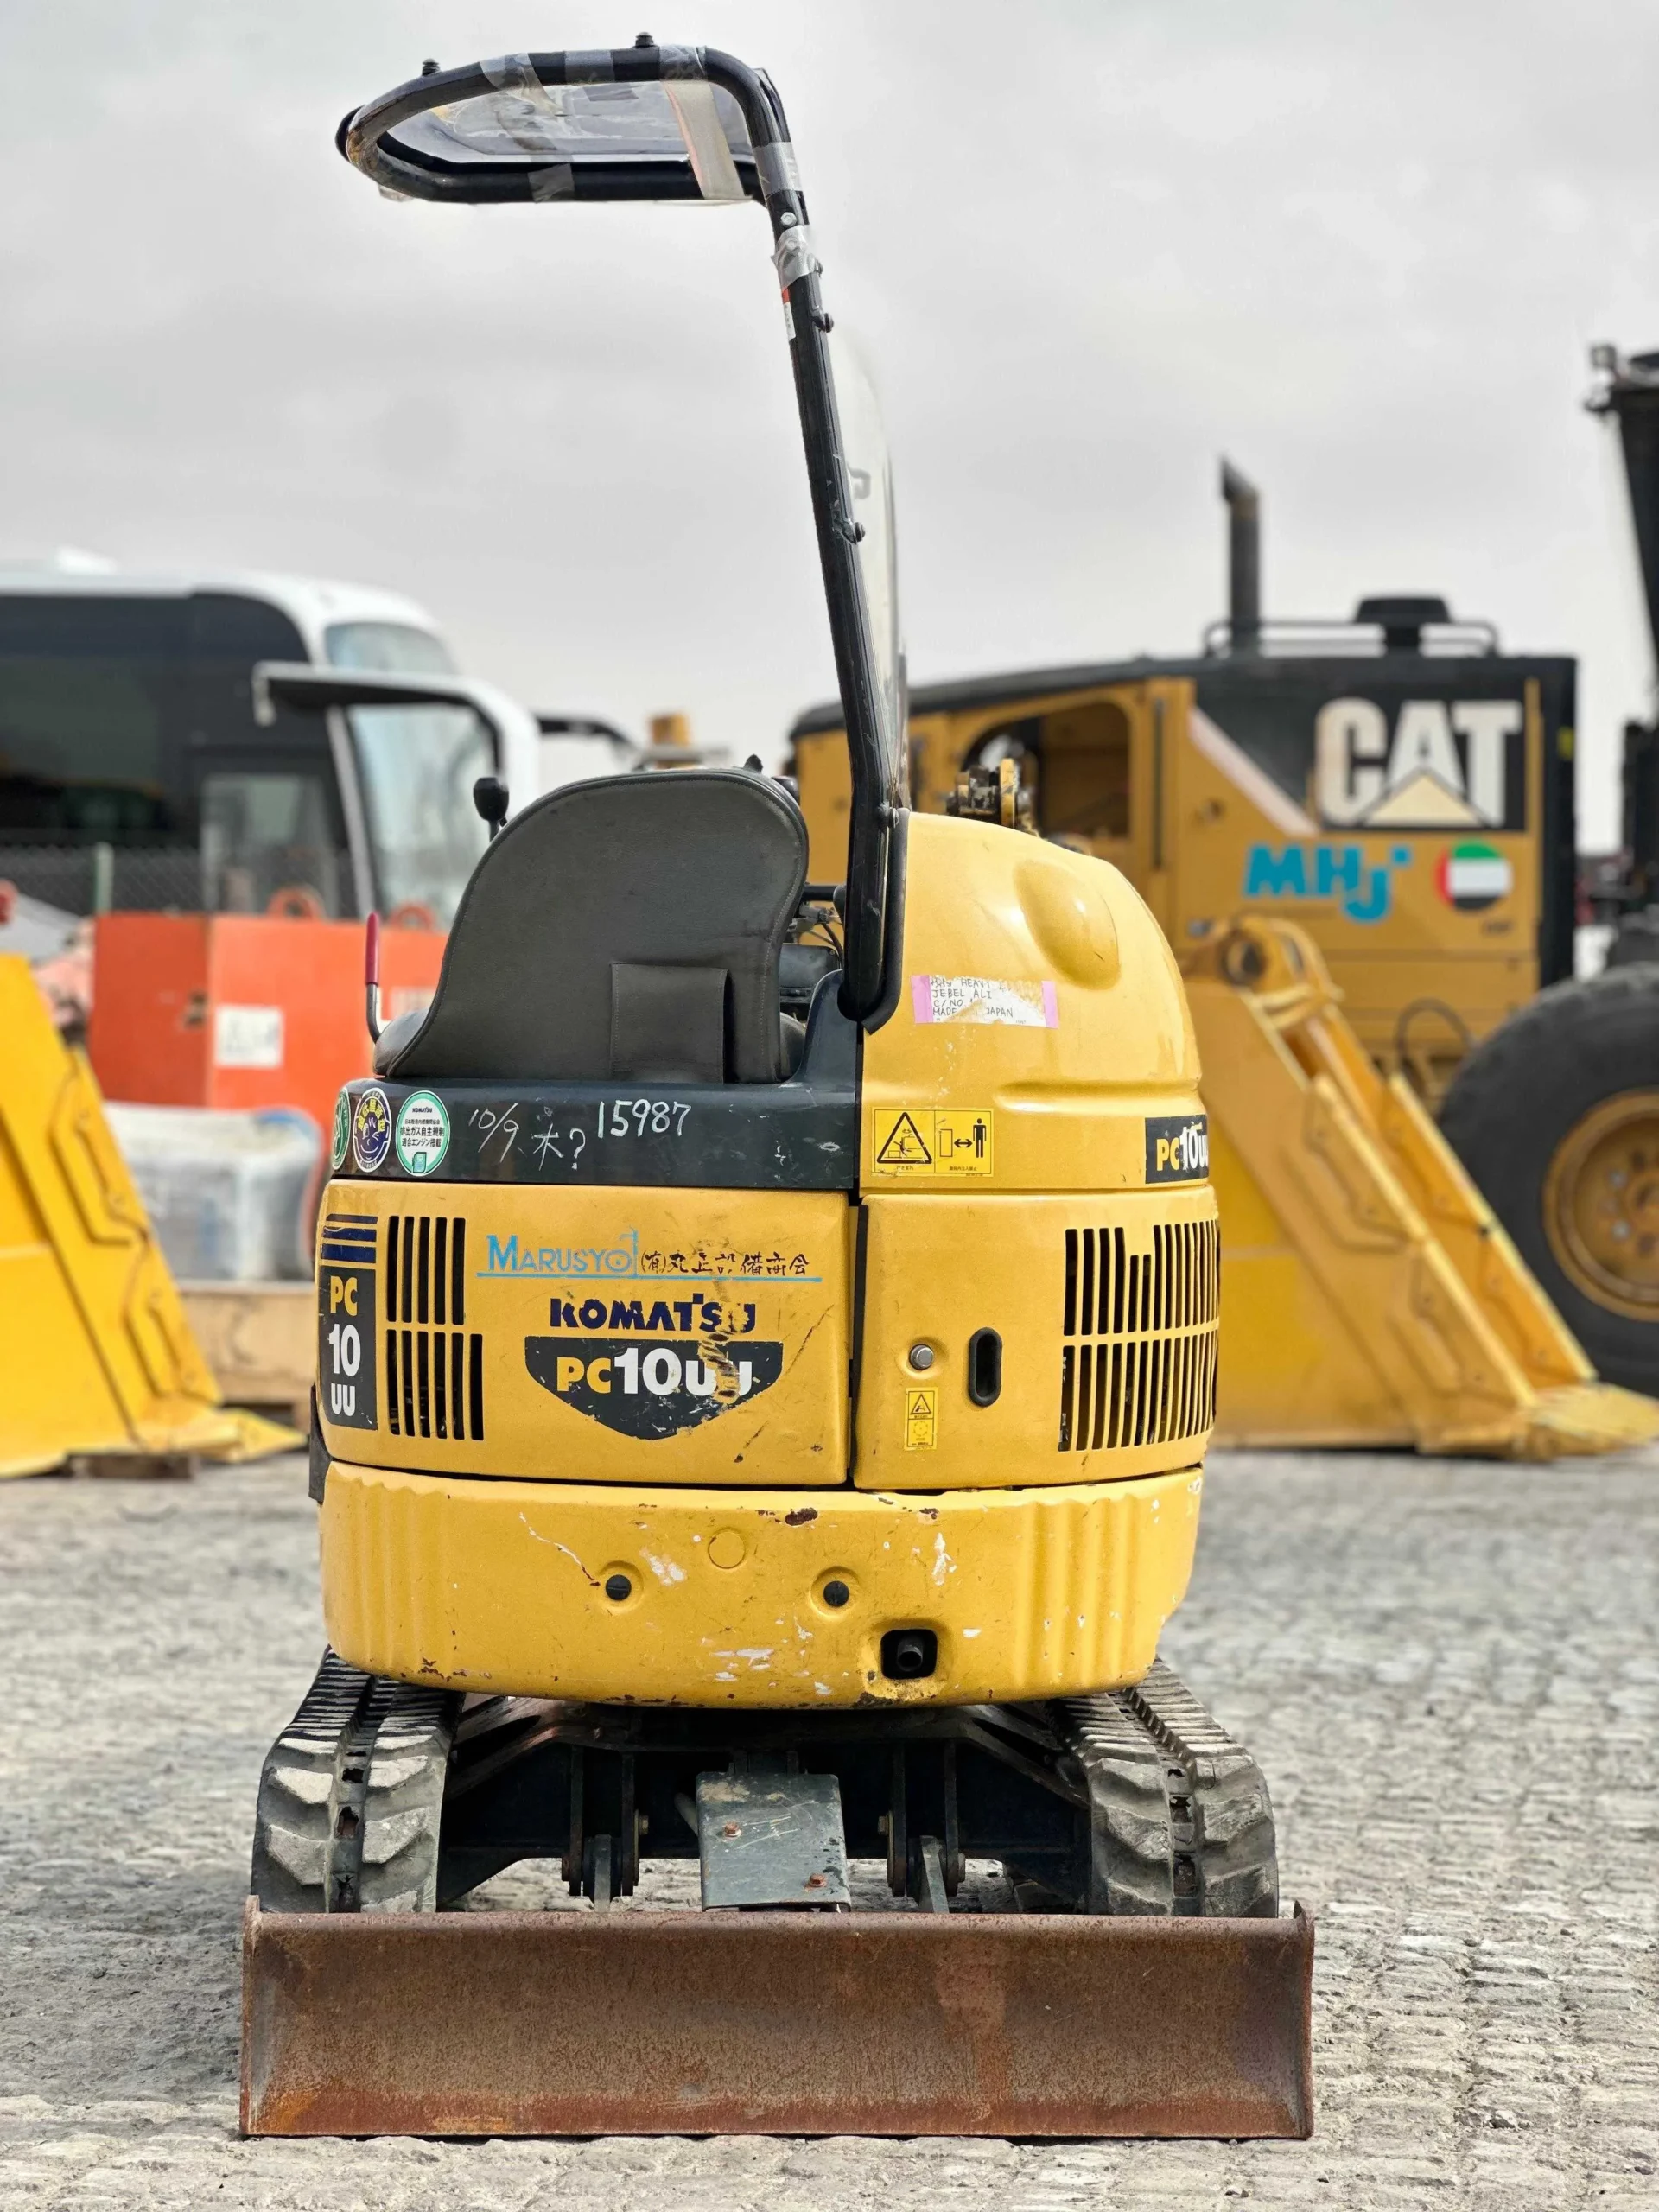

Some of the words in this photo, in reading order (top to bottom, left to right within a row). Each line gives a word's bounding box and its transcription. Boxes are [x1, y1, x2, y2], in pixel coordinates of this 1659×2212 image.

[1315, 696, 1523, 827] CAT
[931, 988, 966, 999] JEBEL
[973, 988, 993, 999] ALI
[932, 1007, 958, 1017] MADE
[986, 1007, 1014, 1018] JAPAN
[597, 1098, 692, 1139] 15987
[330, 1275, 358, 1317] PC
[328, 1324, 361, 1377] 10
[331, 1382, 355, 1417] UU
